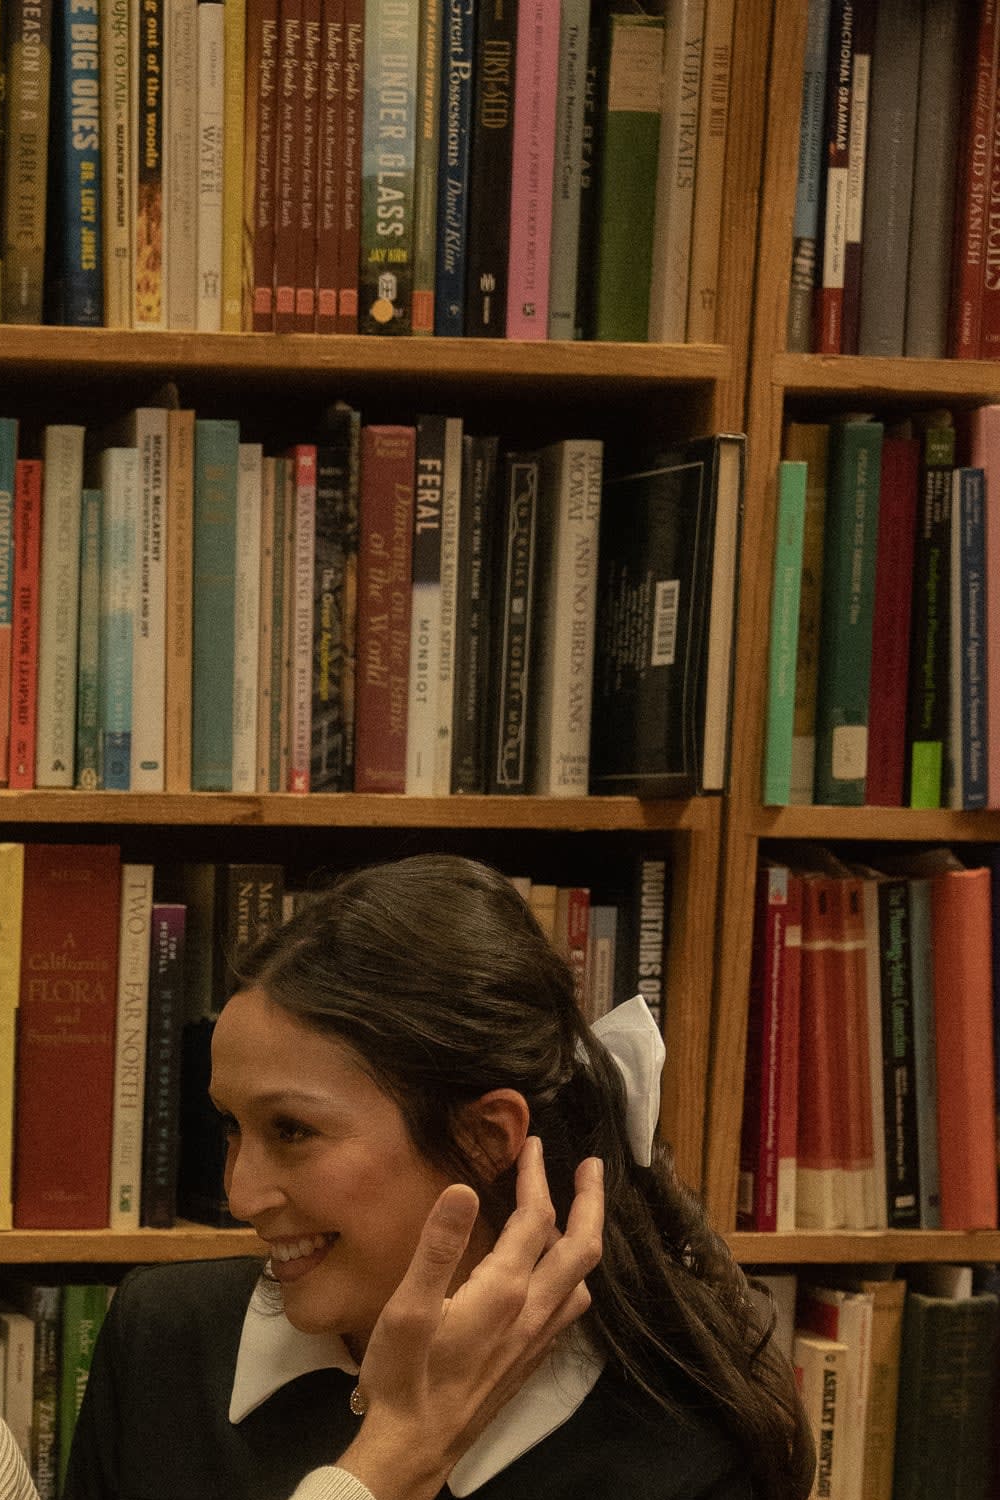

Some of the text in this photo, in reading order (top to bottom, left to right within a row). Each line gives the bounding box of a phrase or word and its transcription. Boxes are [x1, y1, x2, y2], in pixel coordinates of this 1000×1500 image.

[282, 19, 298, 96] Nature Speaks
[324, 23, 341, 100] Nature Speaks
[379, 53, 409, 139] UNDER
[447, 56, 471, 167] Possessions
[676, 38, 702, 189] YUBA TRAILS
[200, 126, 216, 194] WATER
[375, 153, 406, 238] GLASS
[447, 178, 464, 226] David
[444, 229, 462, 275] Kline
[151, 433, 162, 563] MICHAEL McCARTHY
[568, 451, 585, 521] MOWAT
[415, 459, 441, 703] FERAL MONBIOT
[574, 535, 591, 579] AND
[366, 533, 388, 686] of the World
[393, 591, 406, 613] on
[573, 585, 589, 613] NO
[392, 628, 408, 660] the
[571, 620, 587, 676] BIRDS
[390, 674, 407, 736] Brink
[568, 683, 585, 734] SANG
[159, 922, 169, 974] MUSTILL
[638, 860, 666, 1004] MOUNTAINS OF
[28, 979, 104, 1002] FLORA
[818, 1369, 837, 1498] ASHLEY MONTAGU
